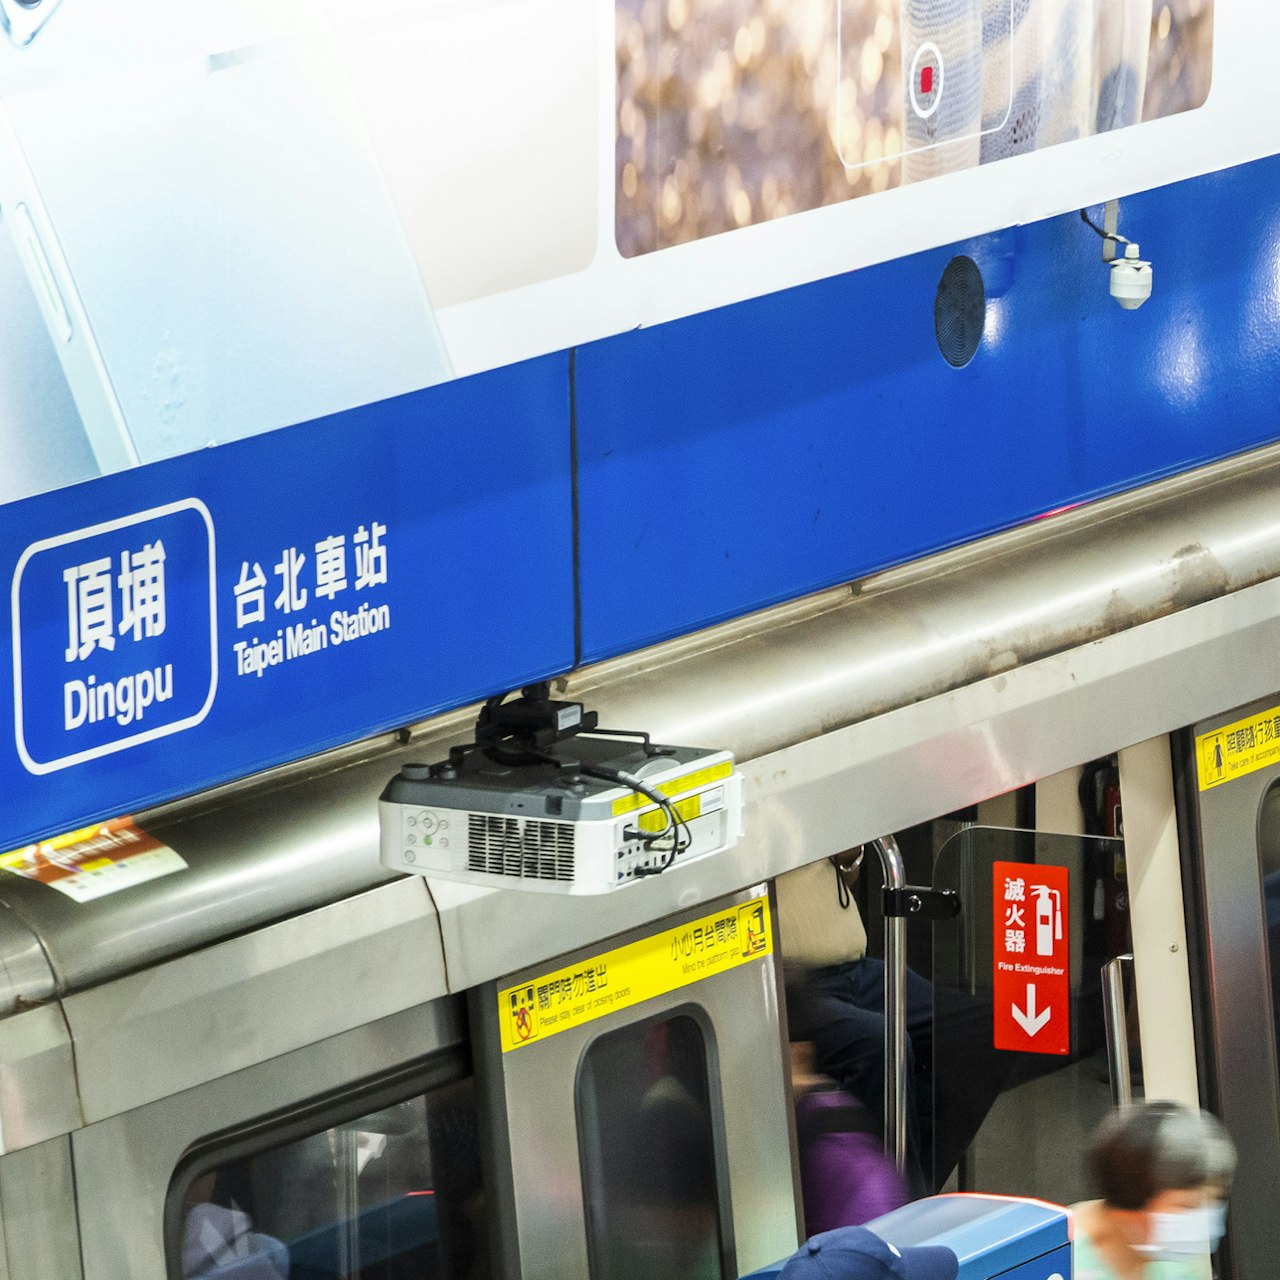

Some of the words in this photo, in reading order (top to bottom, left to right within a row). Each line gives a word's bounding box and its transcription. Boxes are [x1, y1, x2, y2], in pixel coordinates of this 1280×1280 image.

[64, 539, 167, 663] 頂埔
[233, 522, 388, 628] 台北車站
[233, 631, 284, 678] Taipei
[286, 619, 328, 660] Main
[330, 602, 390, 646] Station
[64, 663, 173, 730] Dingpu
[671, 916, 737, 961] 小心月台間隙
[1004, 877, 1026, 953] 滅火器
[998, 962, 1013, 972] Fire
[1015, 963, 1065, 976] Extinguisher
